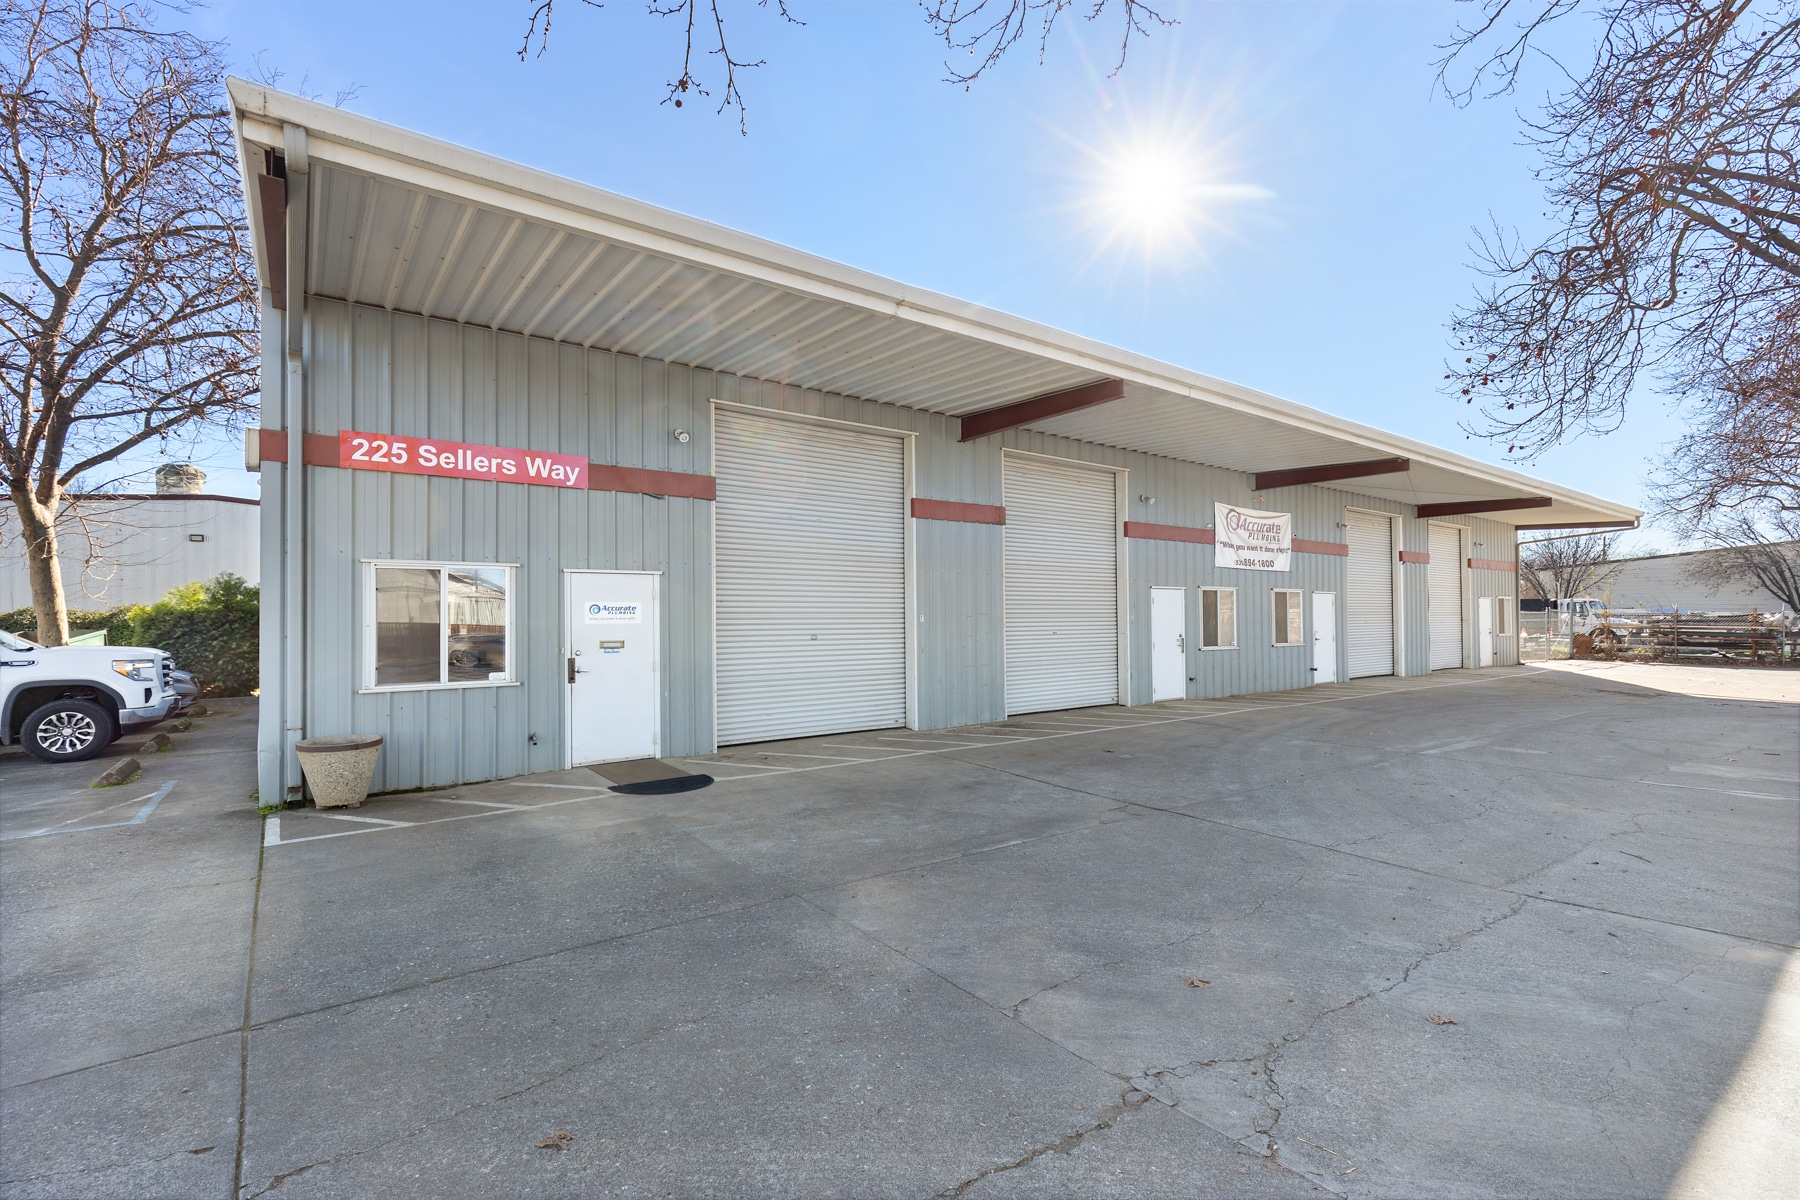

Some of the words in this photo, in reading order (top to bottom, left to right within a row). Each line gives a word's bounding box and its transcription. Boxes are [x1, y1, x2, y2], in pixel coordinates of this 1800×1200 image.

[351, 438, 408, 464] 225
[418, 445, 517, 475] Sellers
[525, 456, 580, 485] Way
[1239, 517, 1281, 534] Accurate
[1247, 532, 1281, 542] PLUMBING
[1235, 544, 1245, 552] you
[601, 604, 637, 612] Accurate
